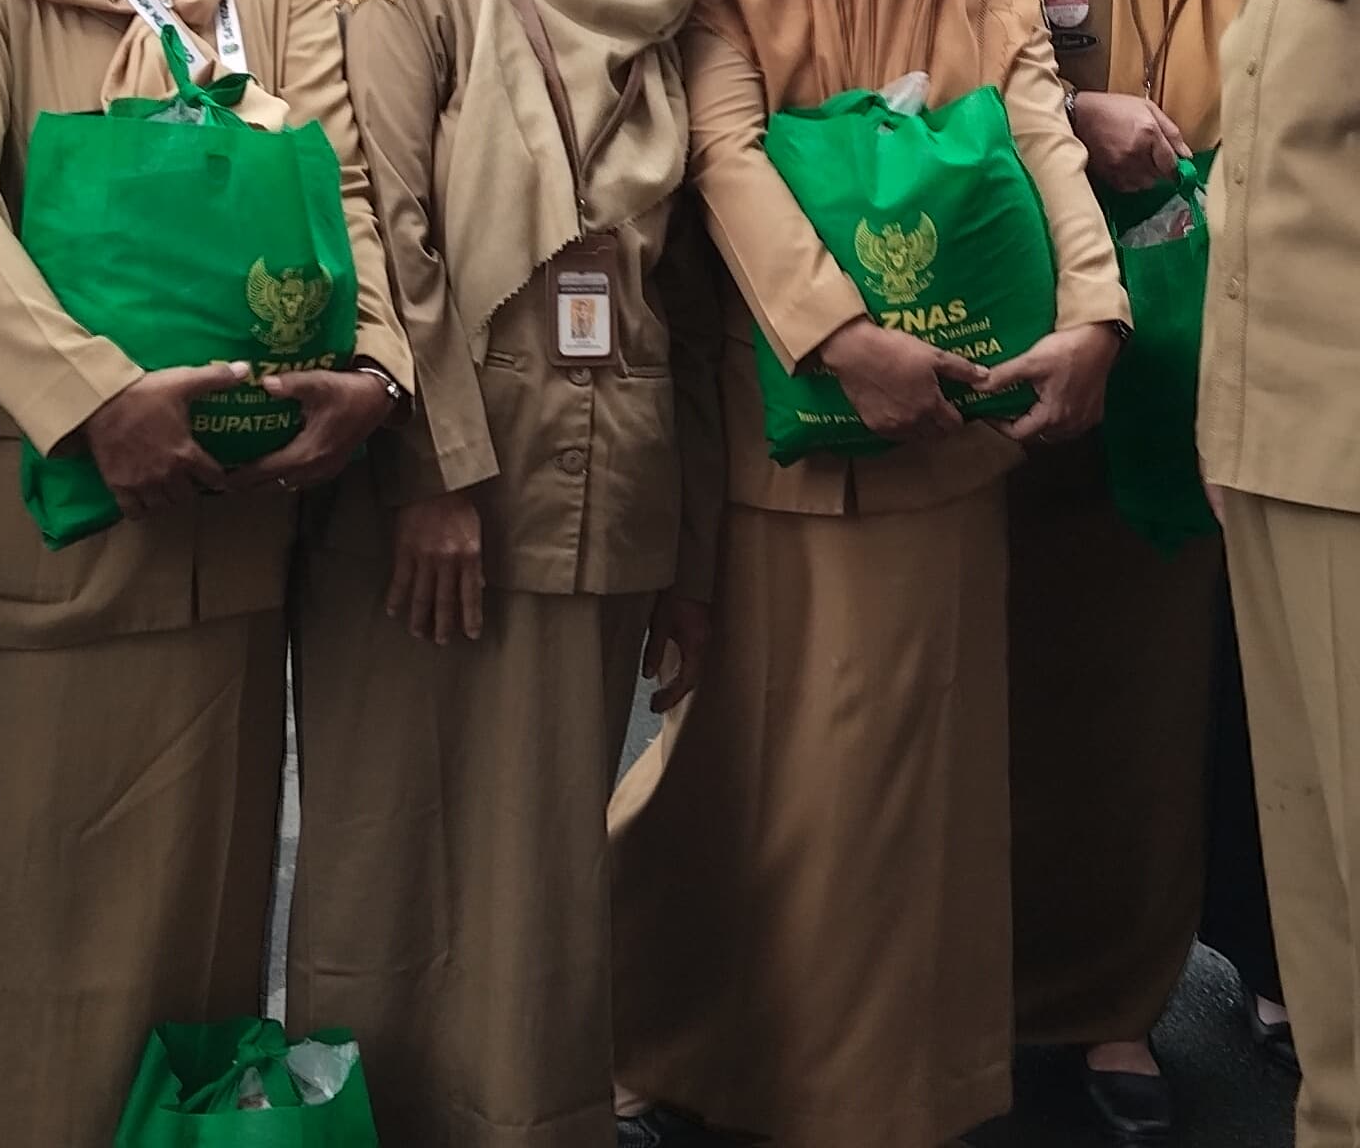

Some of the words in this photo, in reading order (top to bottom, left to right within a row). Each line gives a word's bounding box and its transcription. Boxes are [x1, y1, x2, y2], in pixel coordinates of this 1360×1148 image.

[880, 300, 967, 332] ZNAS
[940, 316, 991, 339] Nasional
[952, 337, 1002, 359] PARA
[192, 414, 290, 432] BUPATEN
